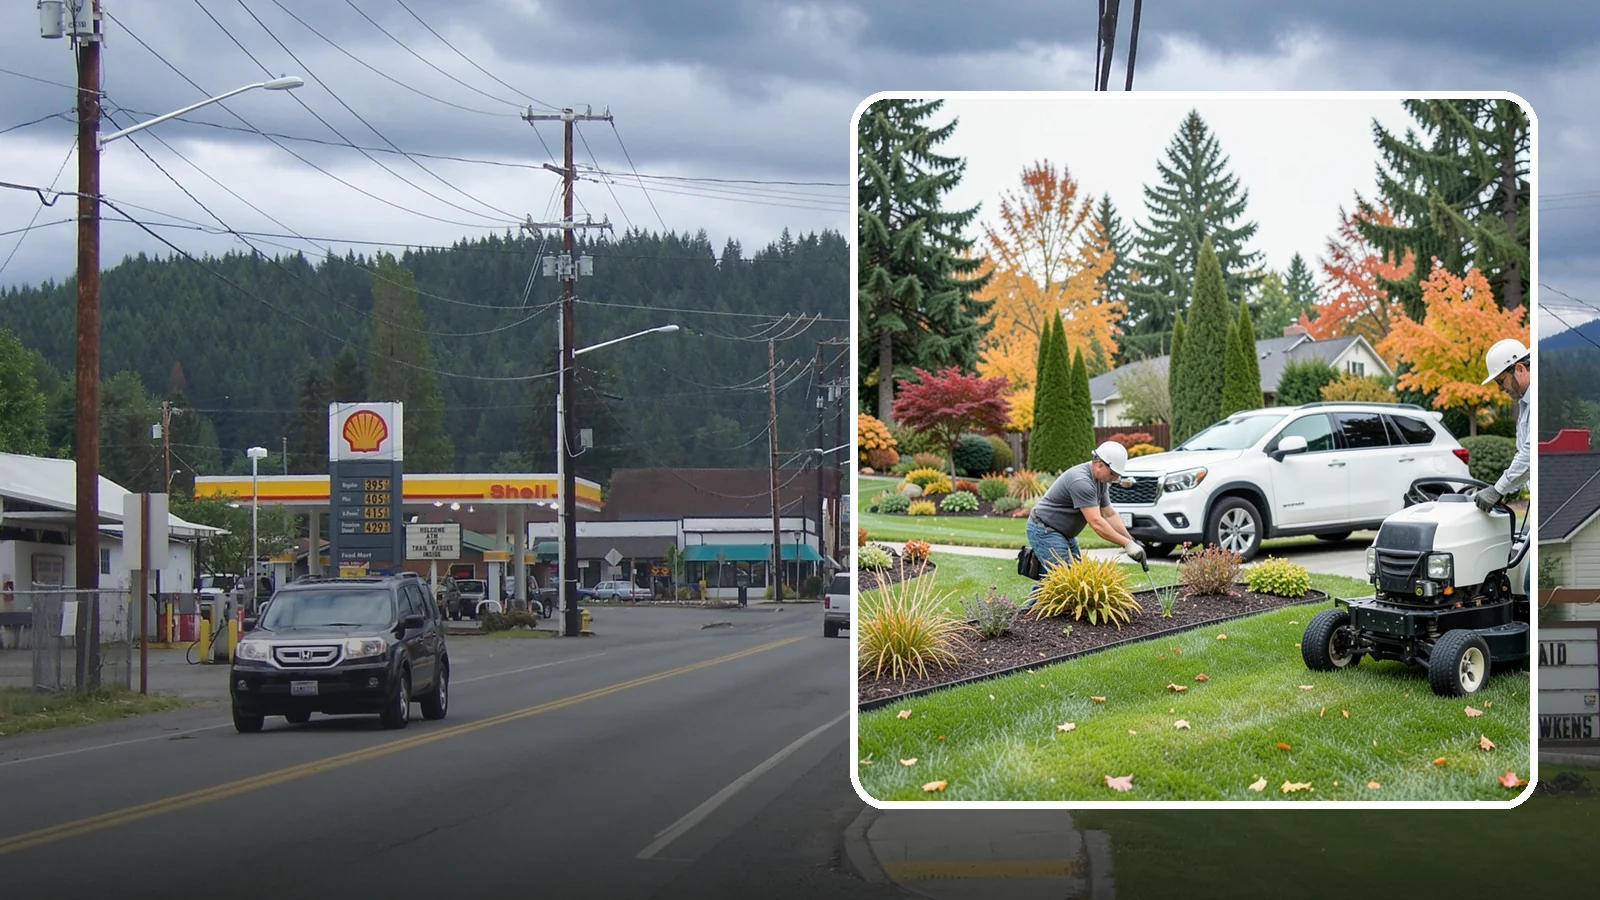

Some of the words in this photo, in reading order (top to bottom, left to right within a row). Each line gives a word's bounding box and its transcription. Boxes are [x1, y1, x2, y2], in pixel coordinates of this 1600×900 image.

[365, 480, 384, 490] 395
[490, 484, 547, 499] Shell
[365, 494, 384, 504] 405
[365, 508, 384, 518] 415
[365, 522, 384, 532] 429
[1538, 643, 1566, 665] AID
